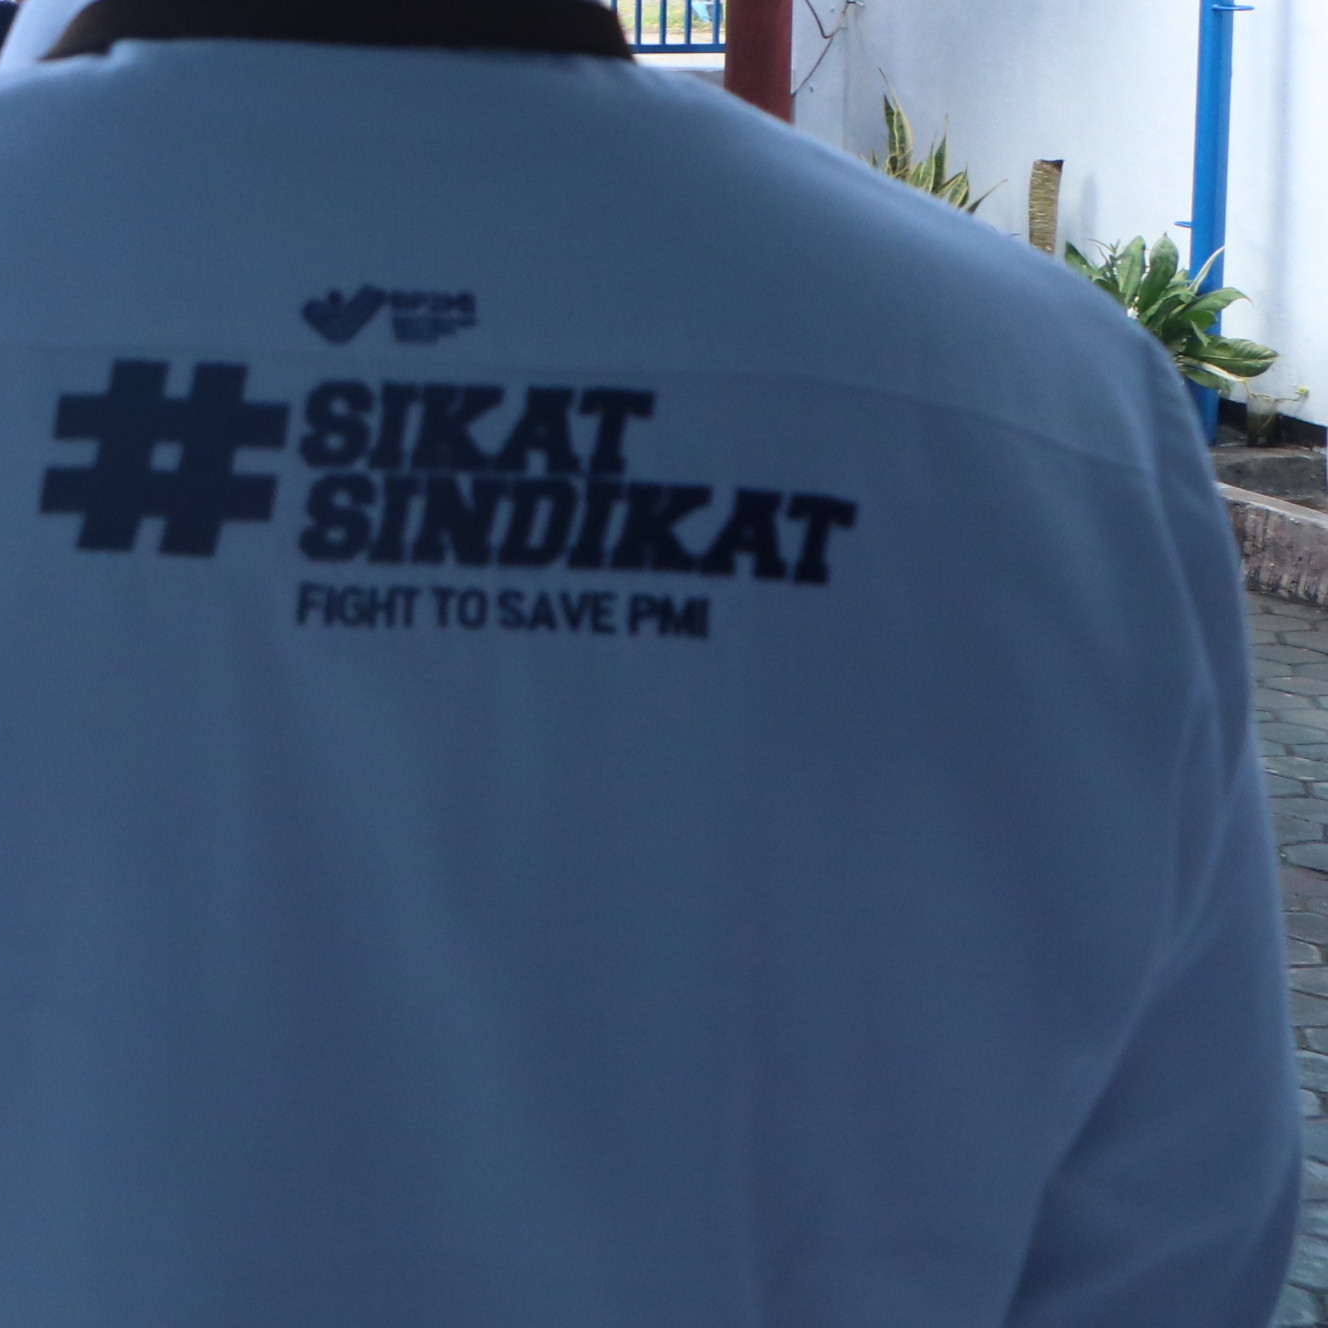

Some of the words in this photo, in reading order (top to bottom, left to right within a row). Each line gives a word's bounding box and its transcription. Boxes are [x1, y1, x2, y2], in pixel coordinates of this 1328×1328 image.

[299, 380, 656, 474] SIKAT
[298, 473, 858, 585] SINDIKAT
[295, 580, 422, 627] FIGHT
[432, 584, 489, 631] TO
[497, 587, 618, 636] SAVE
[627, 591, 711, 640] PMI
